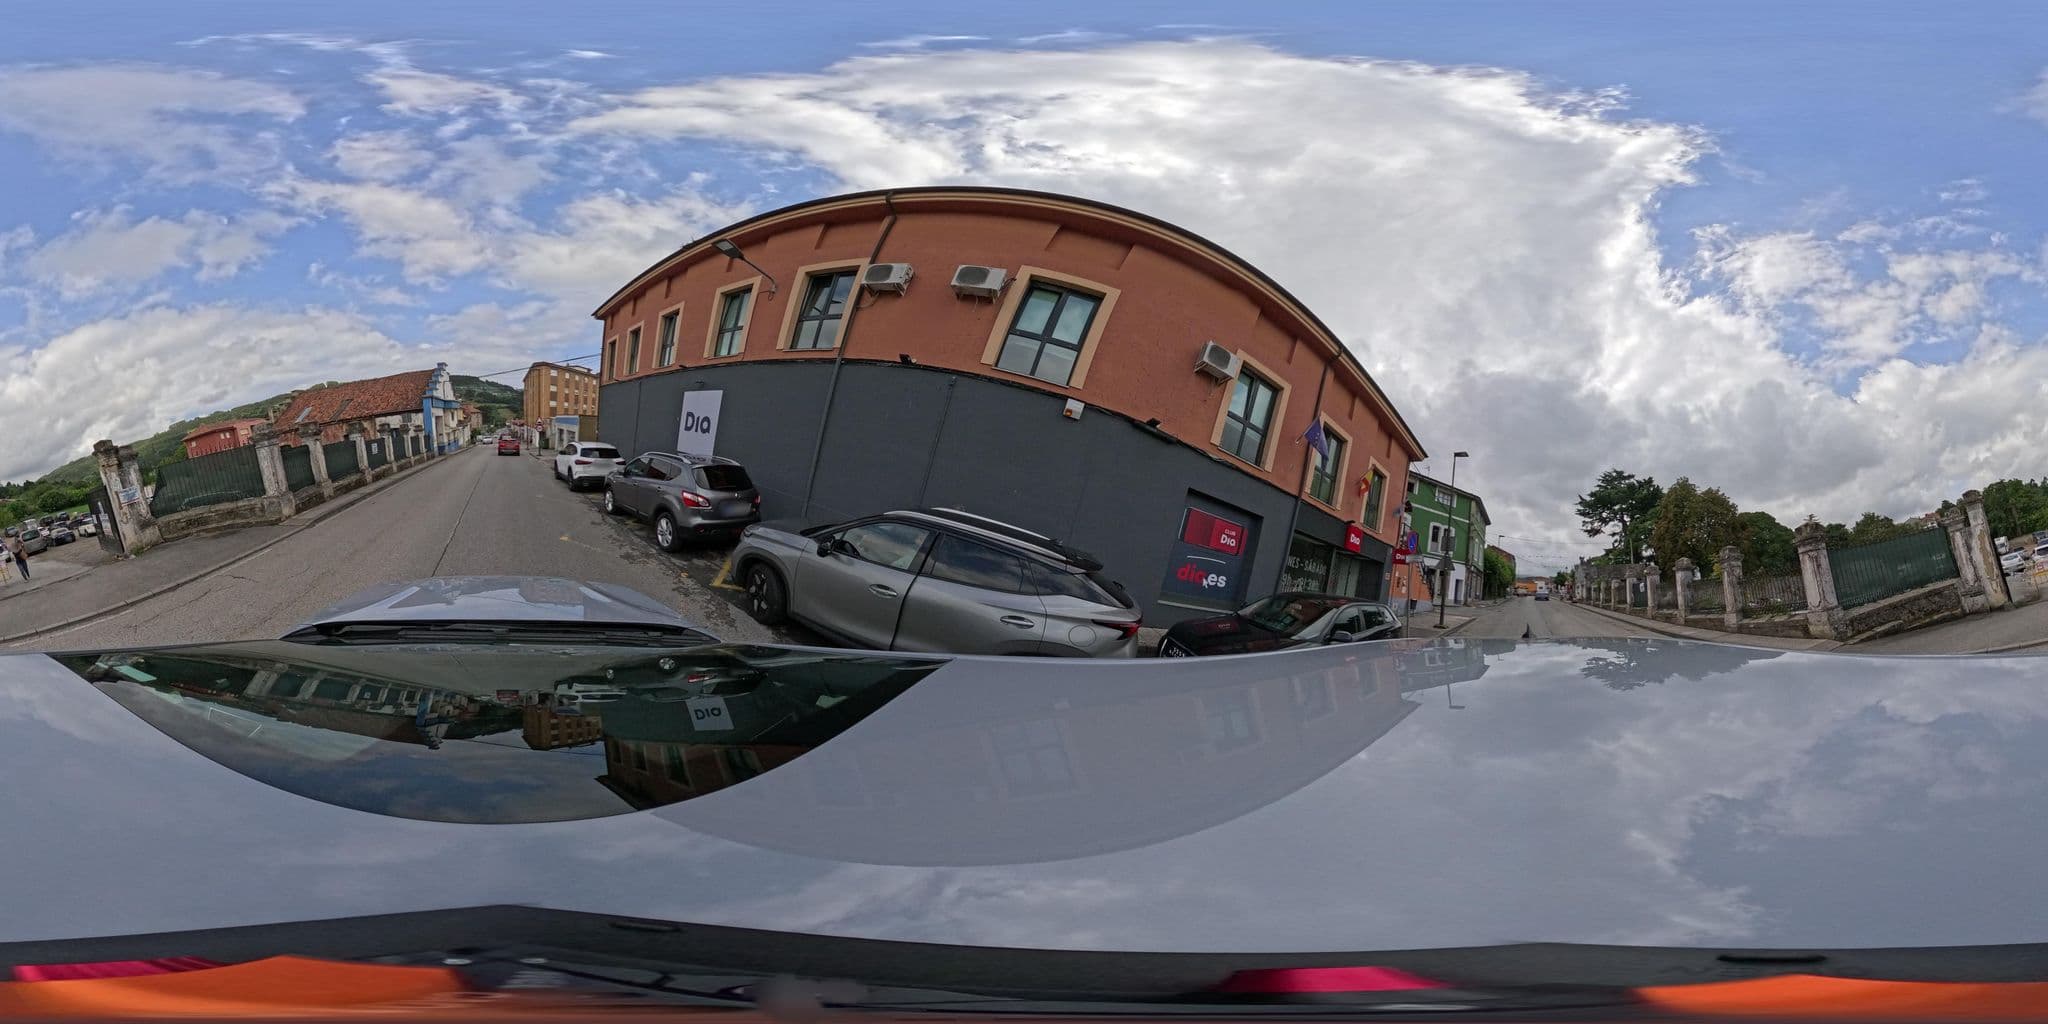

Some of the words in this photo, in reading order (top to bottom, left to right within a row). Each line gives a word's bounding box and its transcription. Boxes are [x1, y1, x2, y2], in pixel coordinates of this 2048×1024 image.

[684, 411, 711, 434] Dia
[1224, 528, 1236, 537] CLUB
[1220, 534, 1236, 547] Dia
[1350, 533, 1361, 545] Dia
